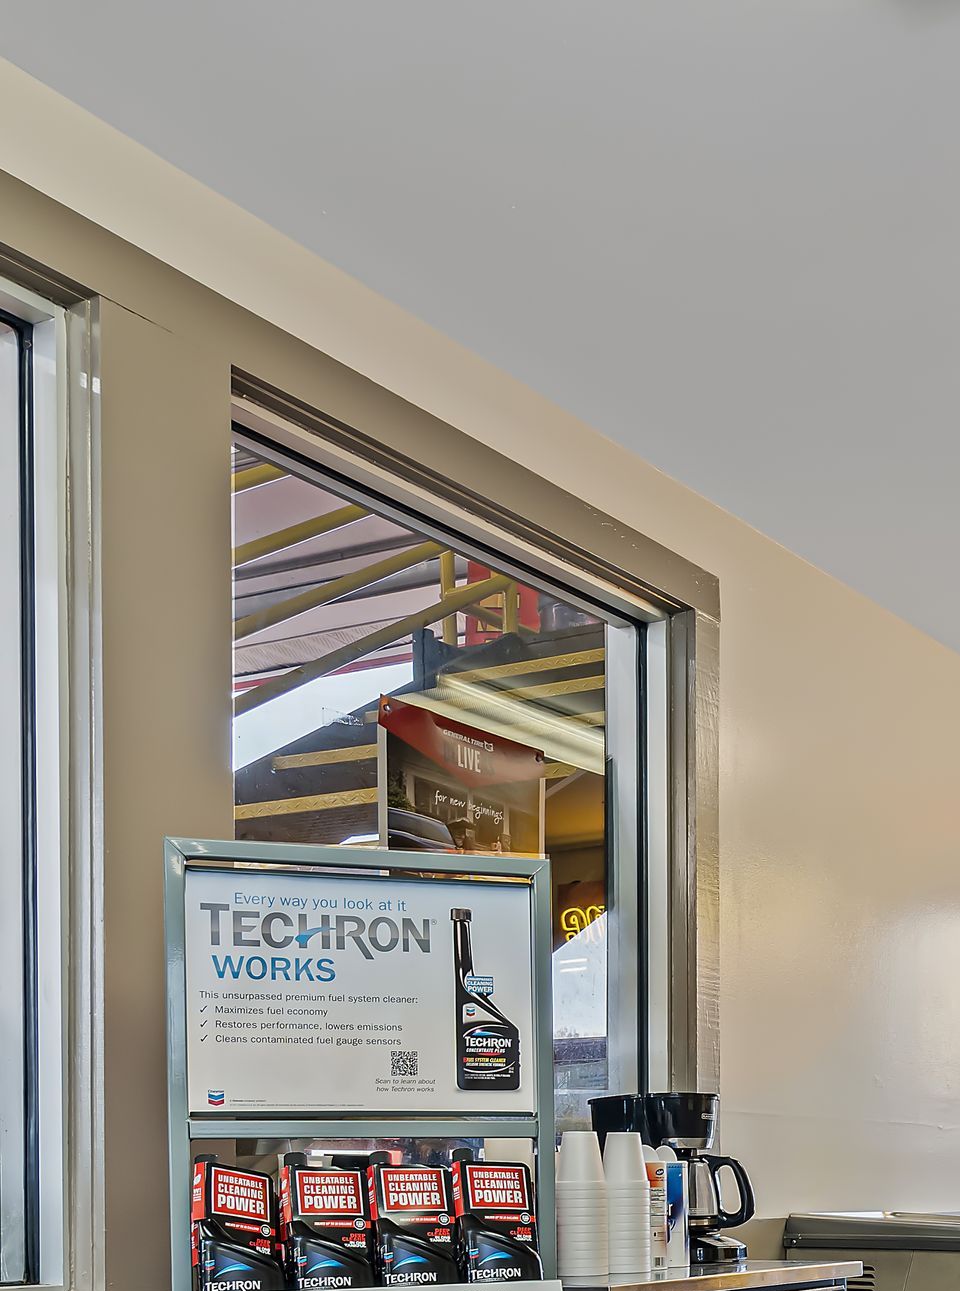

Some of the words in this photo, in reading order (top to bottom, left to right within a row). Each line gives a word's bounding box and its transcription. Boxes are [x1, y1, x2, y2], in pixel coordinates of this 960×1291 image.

[442, 729, 471, 744] GENERAL
[457, 744, 481, 773] LIVE
[434, 790, 448, 805] for
[449, 797, 466, 809] new
[466, 801, 505, 825] beginnings.
[234, 892, 275, 908] Every
[280, 898, 308, 910] way
[312, 898, 338, 910] you
[343, 897, 374, 910] look
[378, 900, 392, 911] at
[397, 899, 407, 911] it
[211, 954, 337, 982] WORKS
[467, 985, 494, 993] POWER
[199, 991, 219, 999] This
[222, 992, 283, 1002] unsurpassed
[285, 993, 326, 1002] premium
[328, 993, 346, 1002] fuel
[348, 995, 381, 1004] system
[382, 995, 419, 1004] cleaner:
[215, 1005, 264, 1015] Maximizes
[267, 1006, 285, 1015] fuel
[286, 1007, 329, 1017] economy
[215, 1020, 258, 1029] Restores
[260, 1020, 323, 1031] performance,
[325, 1021, 355, 1031] lowers
[357, 1023, 403, 1032] emissions
[215, 1034, 248, 1043] Cleans
[250, 1035, 314, 1045] contaminated
[316, 1036, 334, 1045] fuel
[336, 1037, 363, 1047] gauge
[366, 1037, 402, 1046] sensors
[464, 1036, 513, 1050] TECHRON
[217, 1173, 263, 1190] UNBEATABLE
[302, 1176, 354, 1185] UNBEATABLE
[387, 1173, 437, 1182] UNBEATABLE
[472, 1171, 520, 1180] UNBEATABLE
[303, 1184, 355, 1195] CLEANING
[388, 1182, 439, 1192] CLEANING
[473, 1179, 521, 1190] CLEANING
[217, 1184, 264, 1200] CLEANING
[389, 1192, 442, 1206] POWER
[474, 1189, 523, 1204] POWER
[217, 1194, 265, 1215] POWER
[304, 1195, 358, 1210] POWER
[384, 1272, 437, 1285] TECHRON
[470, 1267, 522, 1281] TECHRON
[297, 1276, 352, 1290] TECHRON
